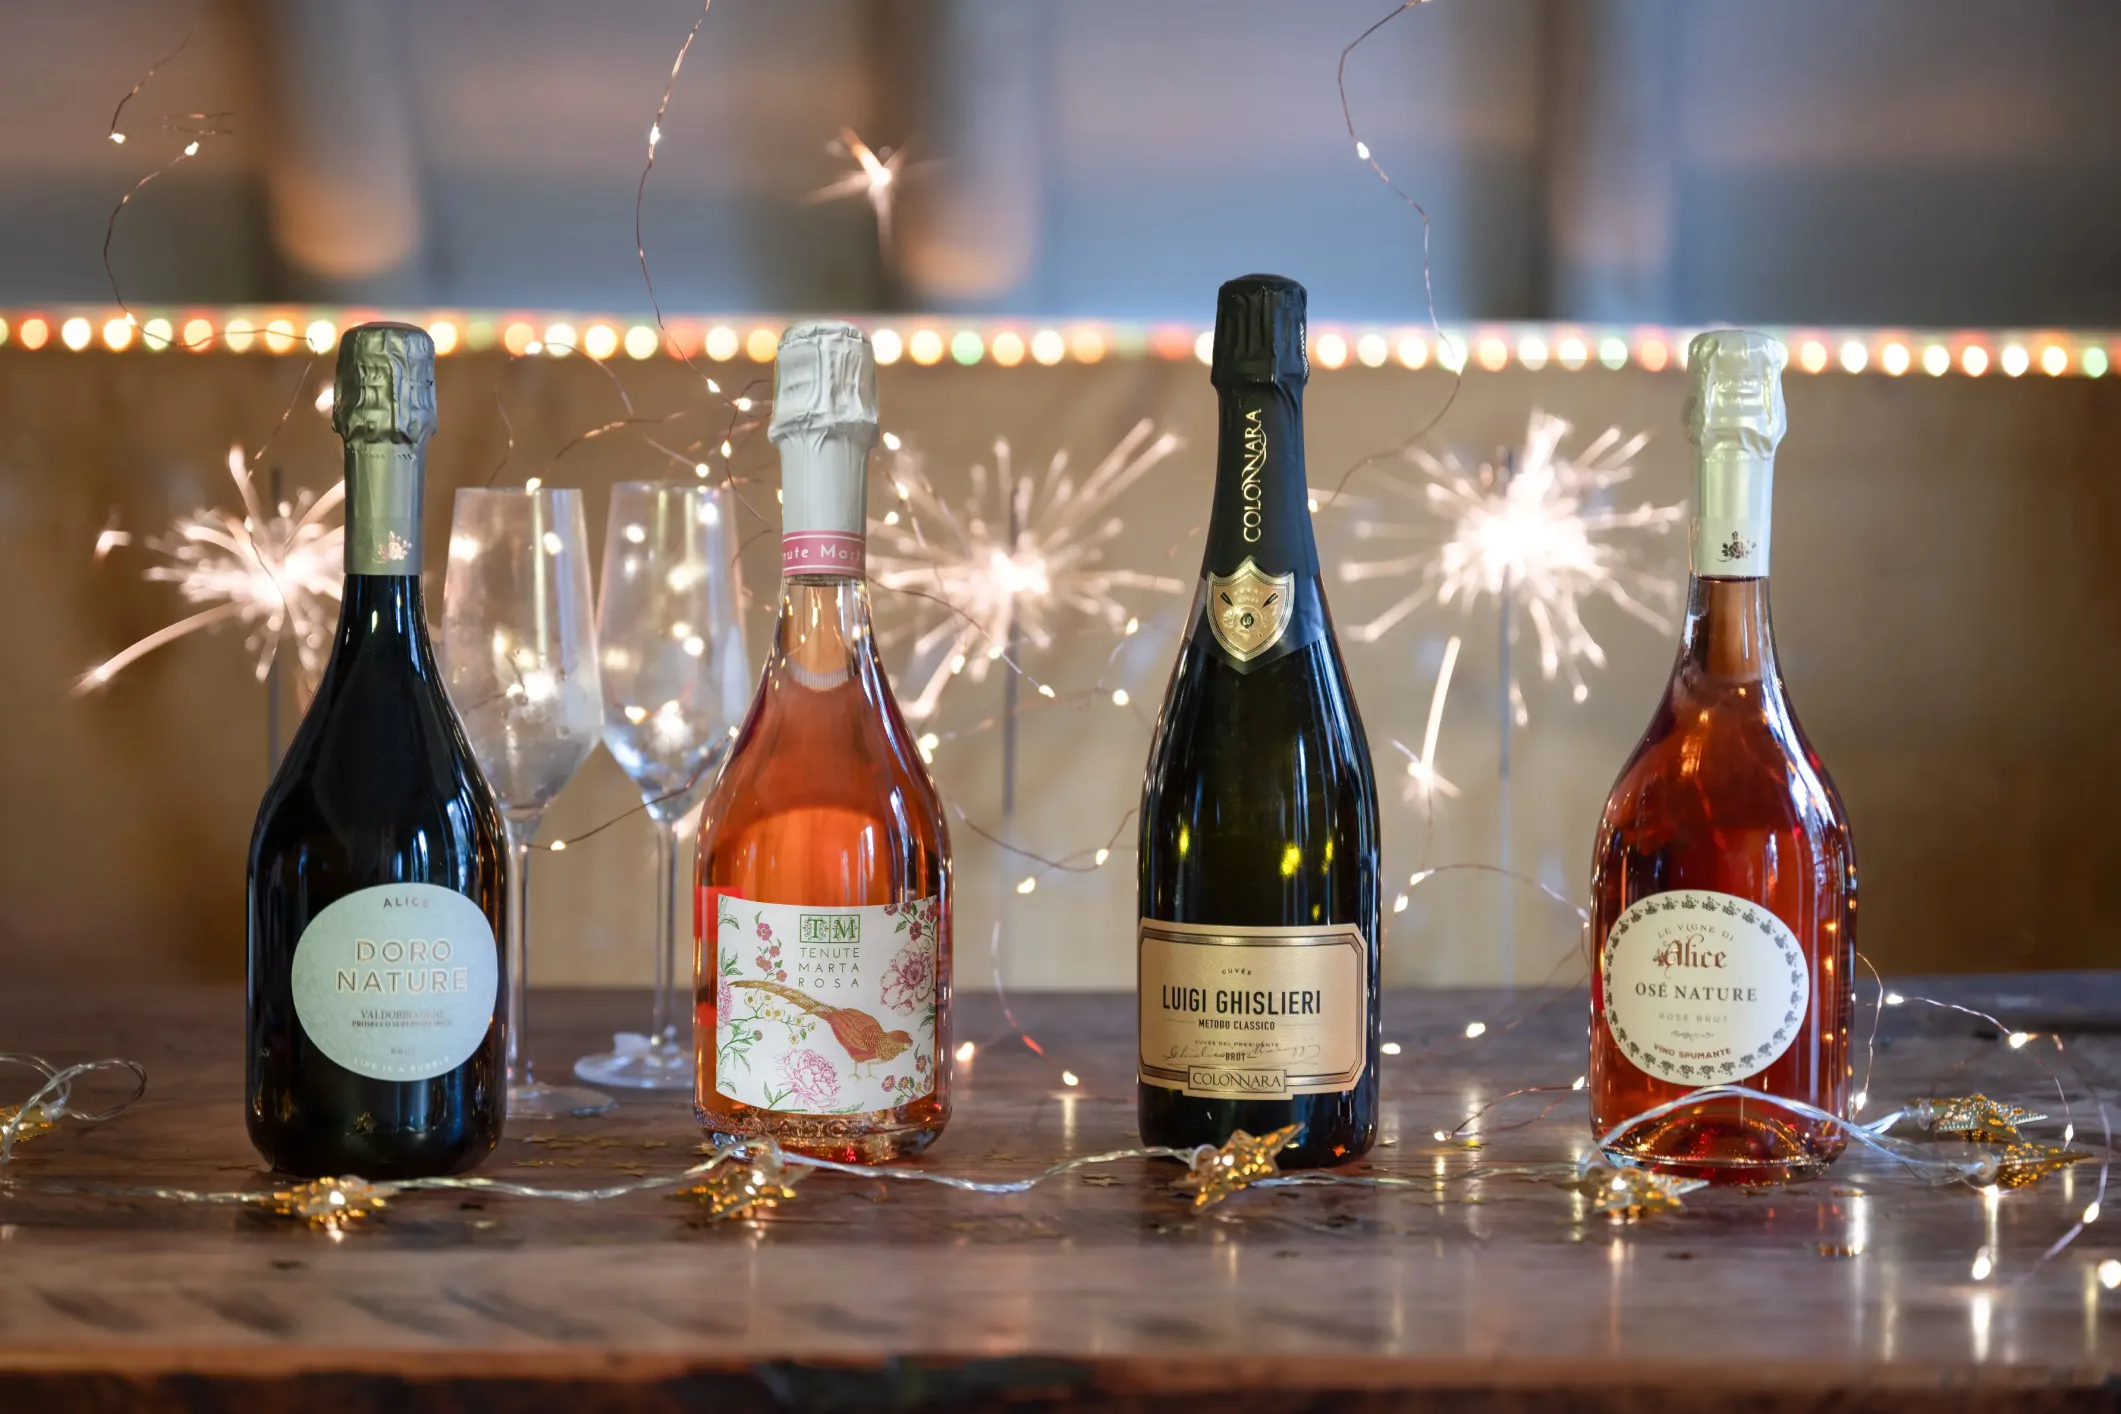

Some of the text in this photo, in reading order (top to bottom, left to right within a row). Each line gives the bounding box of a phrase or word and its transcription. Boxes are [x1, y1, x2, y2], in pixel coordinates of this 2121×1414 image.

[1242, 407, 1267, 542] COLONNARA
[383, 897, 430, 908] ALICE
[1677, 923, 1716, 933] VIGNE
[1721, 930, 1735, 941] DI
[354, 938, 454, 965] DORO
[800, 947, 860, 959] TENUTE
[1657, 934, 1727, 978] Alice
[798, 962, 860, 973] MARTA
[336, 967, 468, 995] NATURE
[798, 977, 860, 988] ROSA
[1162, 984, 1321, 1015] LUIGI GHISLIERI
[1635, 982, 1758, 1002] OSÉ NATURE
[1198, 1018, 1275, 1031] METODO CLASSICO
[1696, 1014, 1728, 1023] BRUT
[1225, 1052, 1246, 1062] BRUT
[1653, 1043, 1732, 1060] VINO SPUMANTE
[1192, 1072, 1282, 1091] COLONNARA
